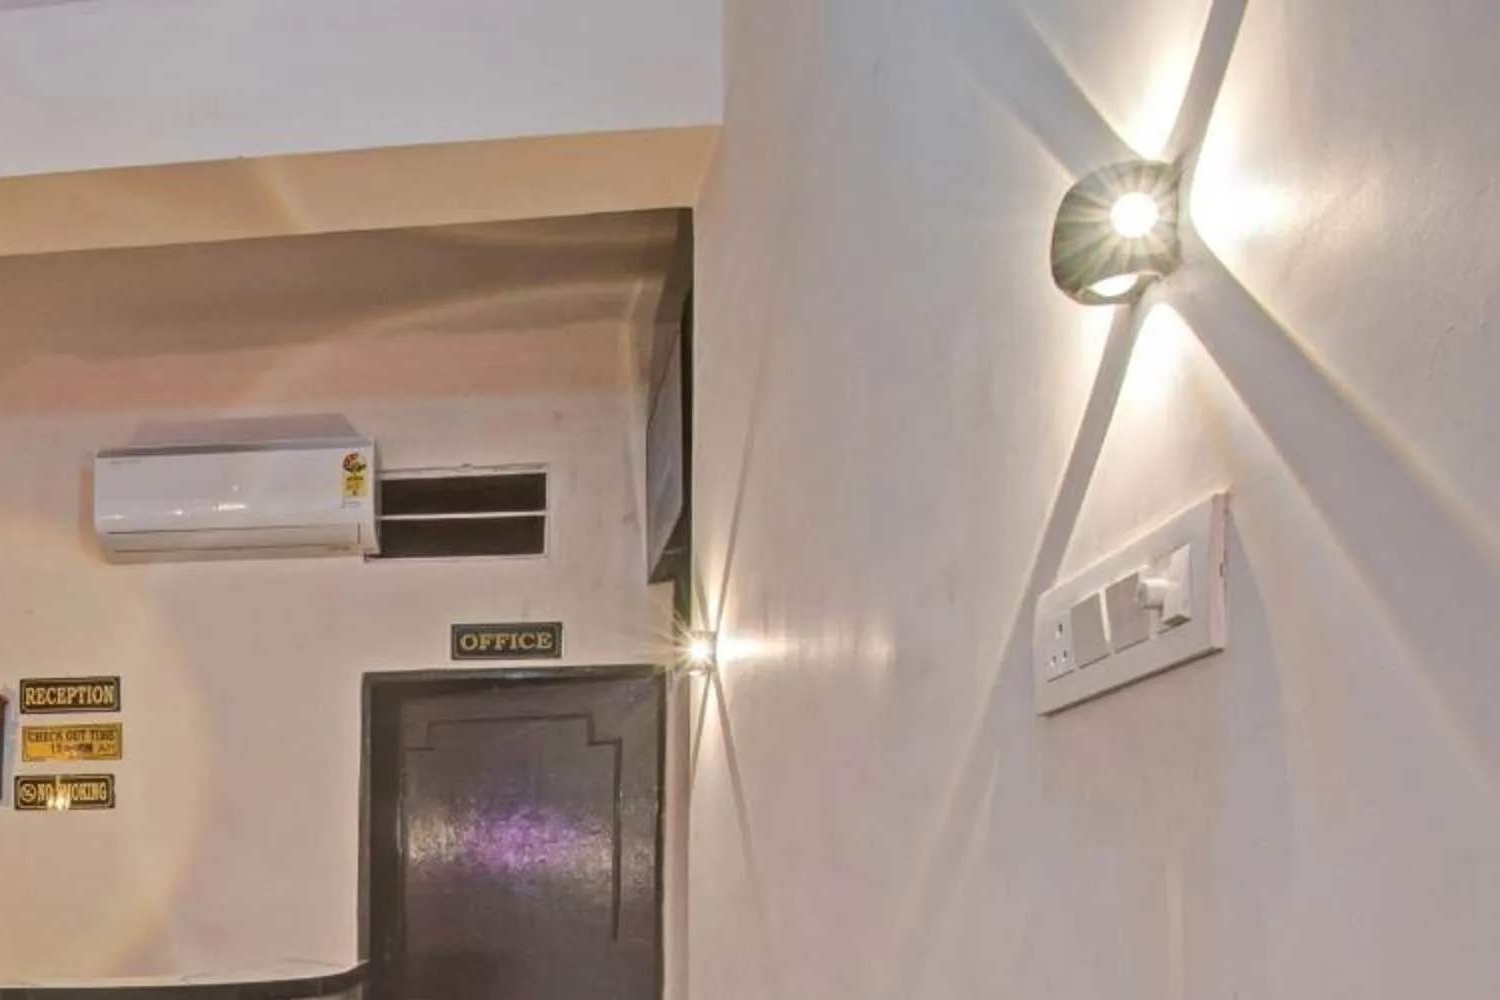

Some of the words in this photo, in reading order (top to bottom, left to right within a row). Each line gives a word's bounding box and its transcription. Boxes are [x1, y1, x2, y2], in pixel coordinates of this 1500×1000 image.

[460, 631, 553, 651] OFFICE
[25, 685, 115, 705] RECEPTION
[27, 731, 63, 742] CHECK
[66, 729, 86, 741] OUT
[37, 783, 54, 801] NO
